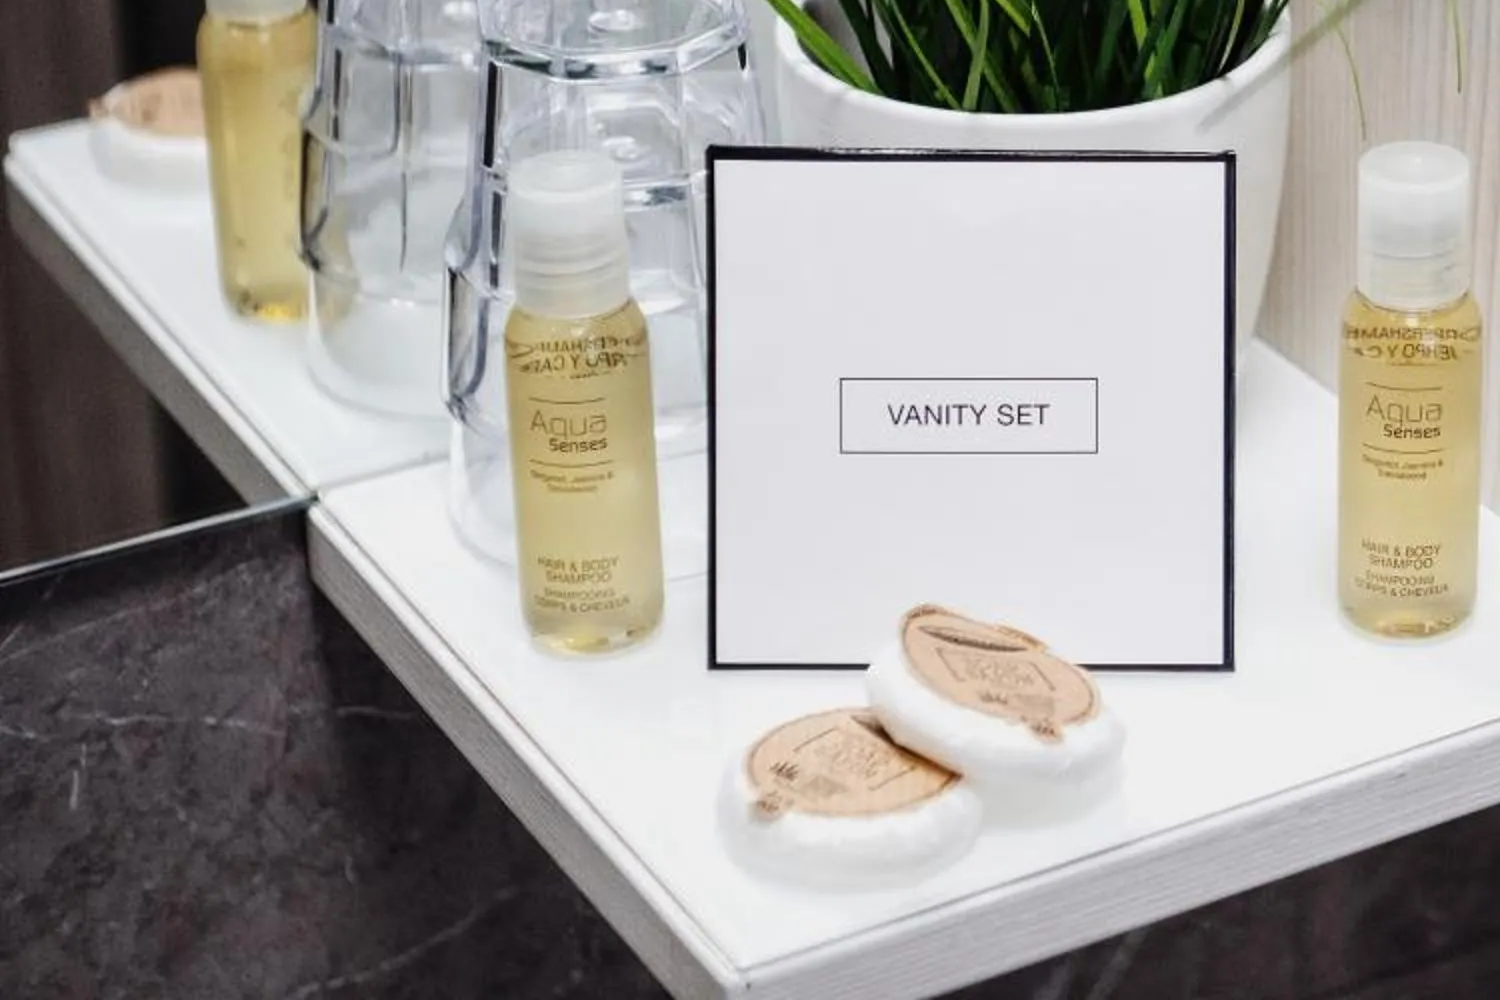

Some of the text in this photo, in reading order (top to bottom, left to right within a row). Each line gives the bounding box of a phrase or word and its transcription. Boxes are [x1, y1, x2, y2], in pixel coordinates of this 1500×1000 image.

[887, 403, 1051, 425] VANITY SET
[1366, 394, 1442, 428] Aqua
[529, 409, 607, 440] Aqua
[1383, 423, 1441, 439] Senses
[549, 437, 608, 453] Senses
